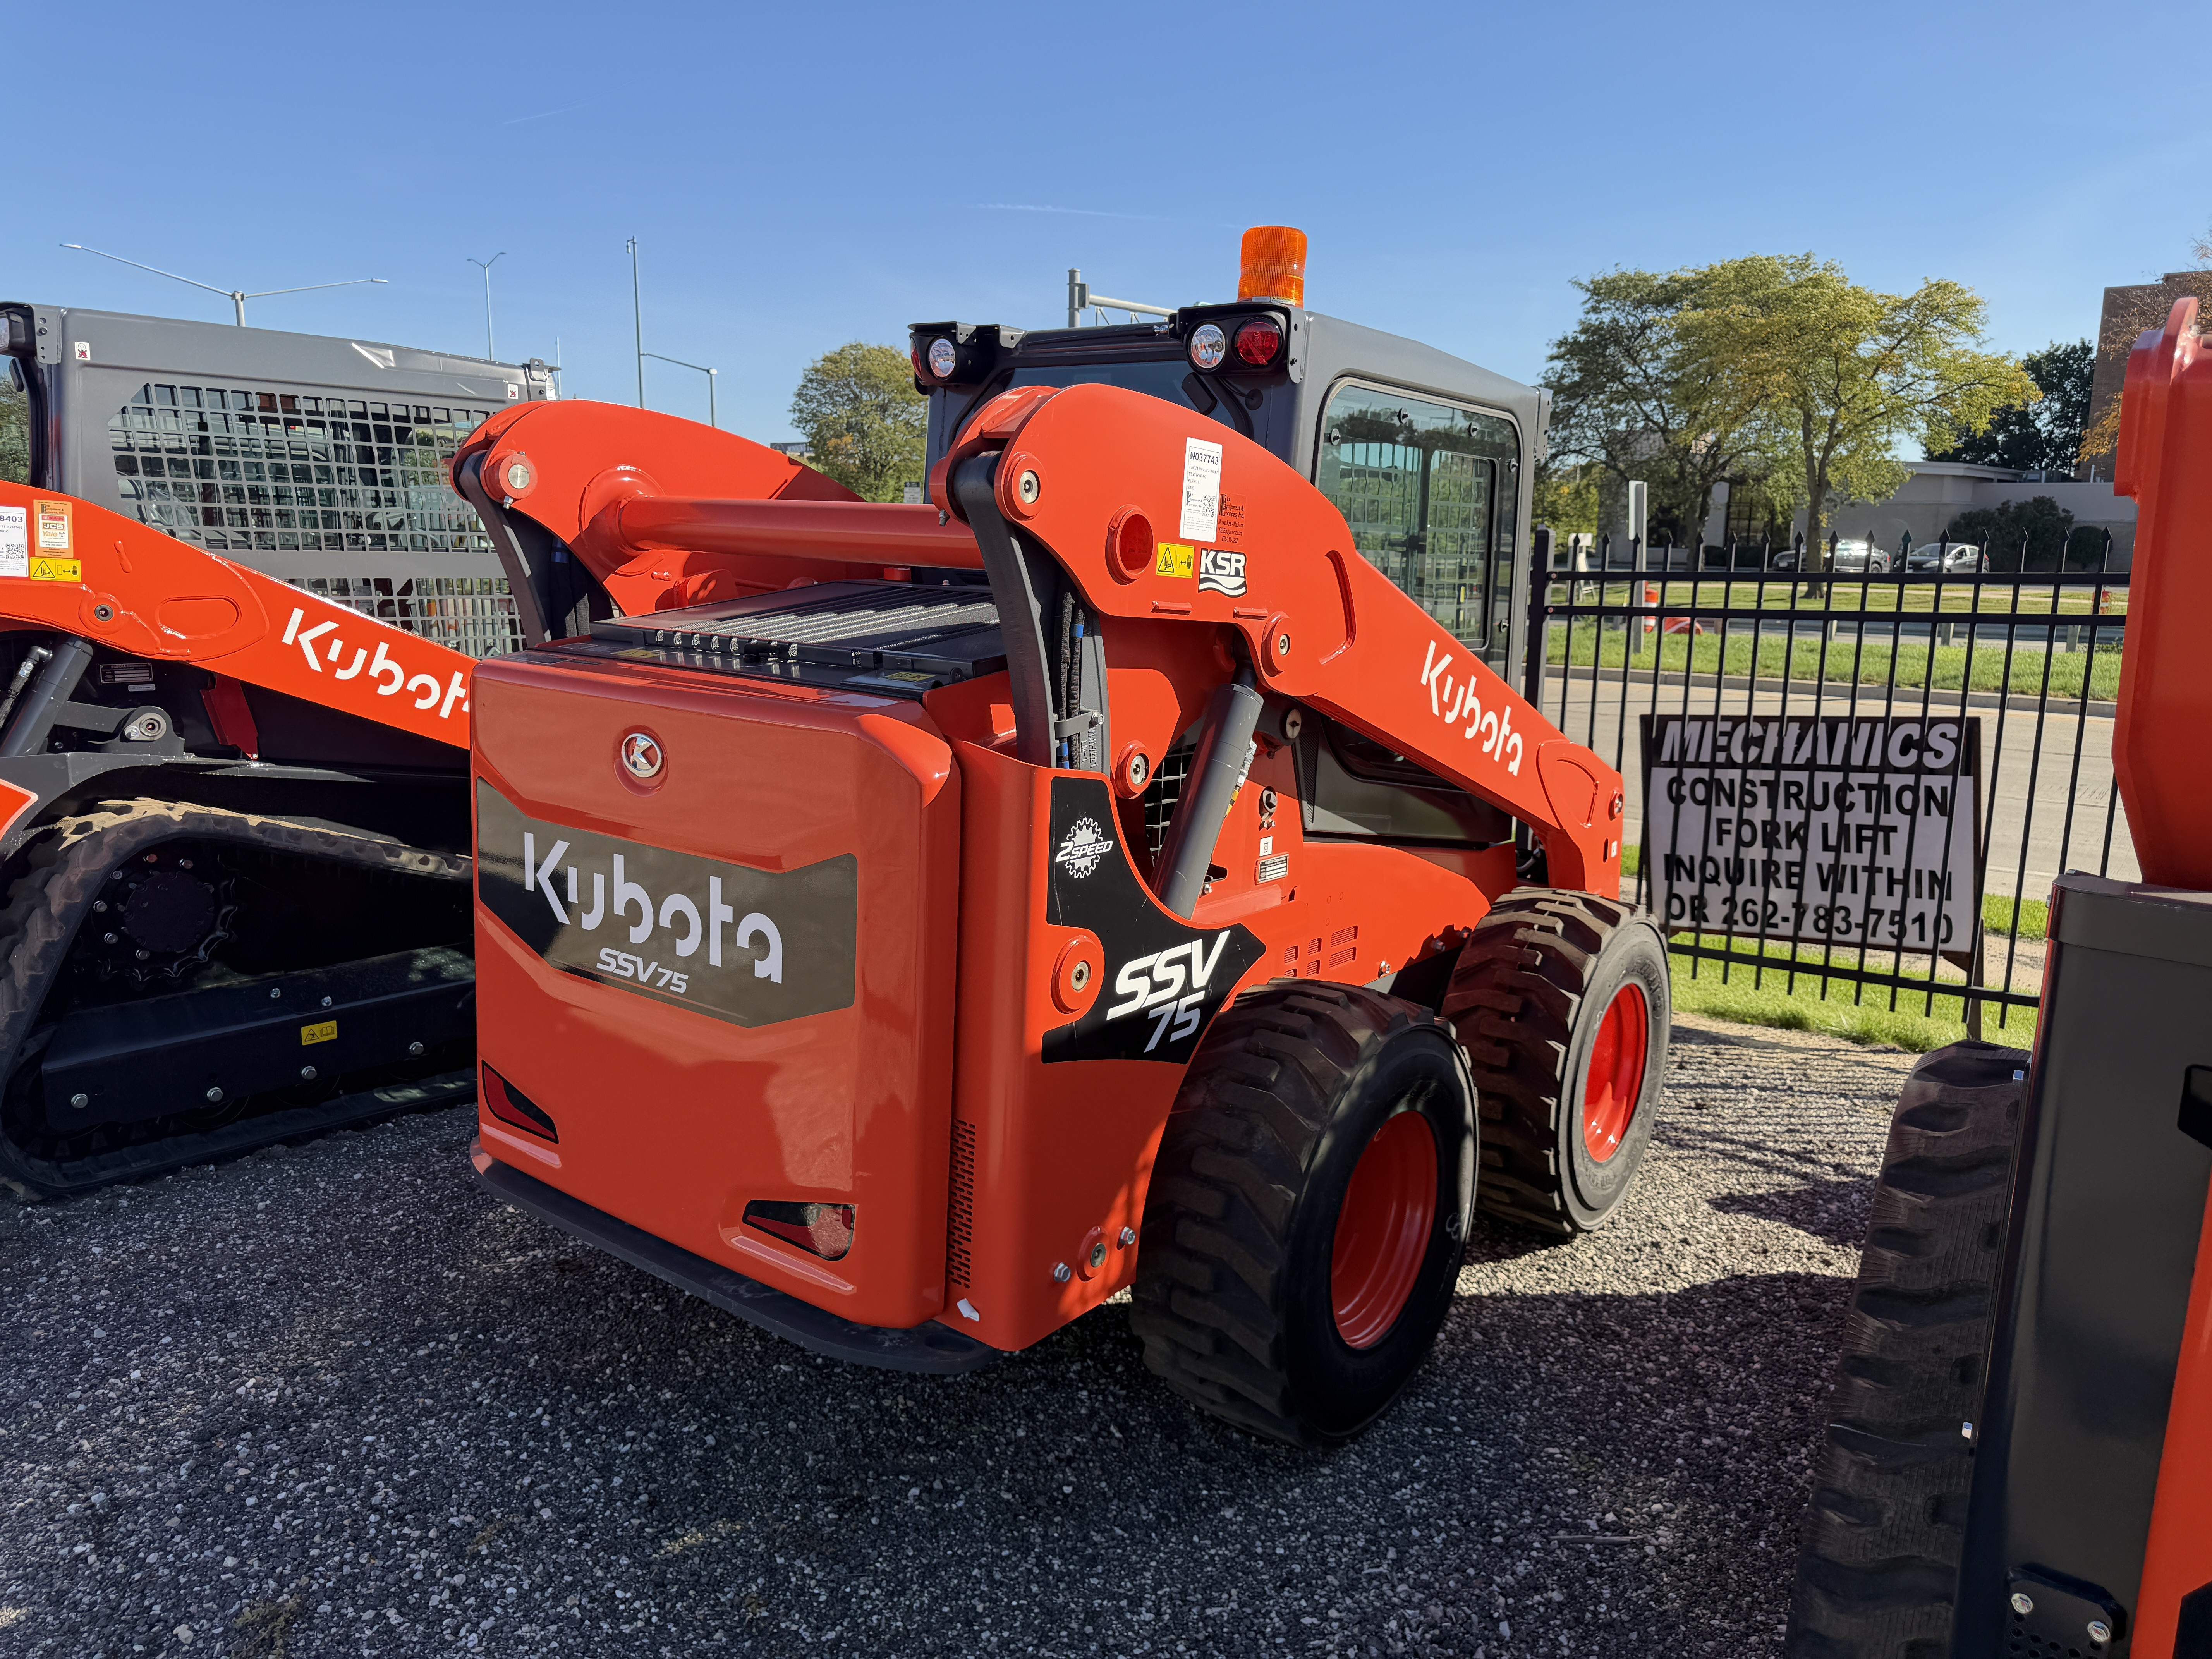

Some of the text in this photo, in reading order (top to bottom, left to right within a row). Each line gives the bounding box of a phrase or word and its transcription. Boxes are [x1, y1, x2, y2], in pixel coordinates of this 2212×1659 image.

[1190, 451, 1219, 465] N037743
[1200, 550, 1245, 577] KSR
[282, 607, 469, 719] Kubot
[1420, 639, 1523, 777] Kubota
[1660, 721, 1958, 769] MECHANICS
[1667, 776, 1948, 817] CONSTRUCTION
[1716, 817, 1898, 855] FORK LIFT
[1664, 854, 1952, 901] INQUIRE WITHIN
[524, 832, 783, 984] Kubota
[1665, 893, 1953, 944] OR 262-783-7510
[596, 947, 689, 993] SSV 75
[1106, 930, 1231, 1021] SSV
[1144, 990, 1206, 1053] 75
